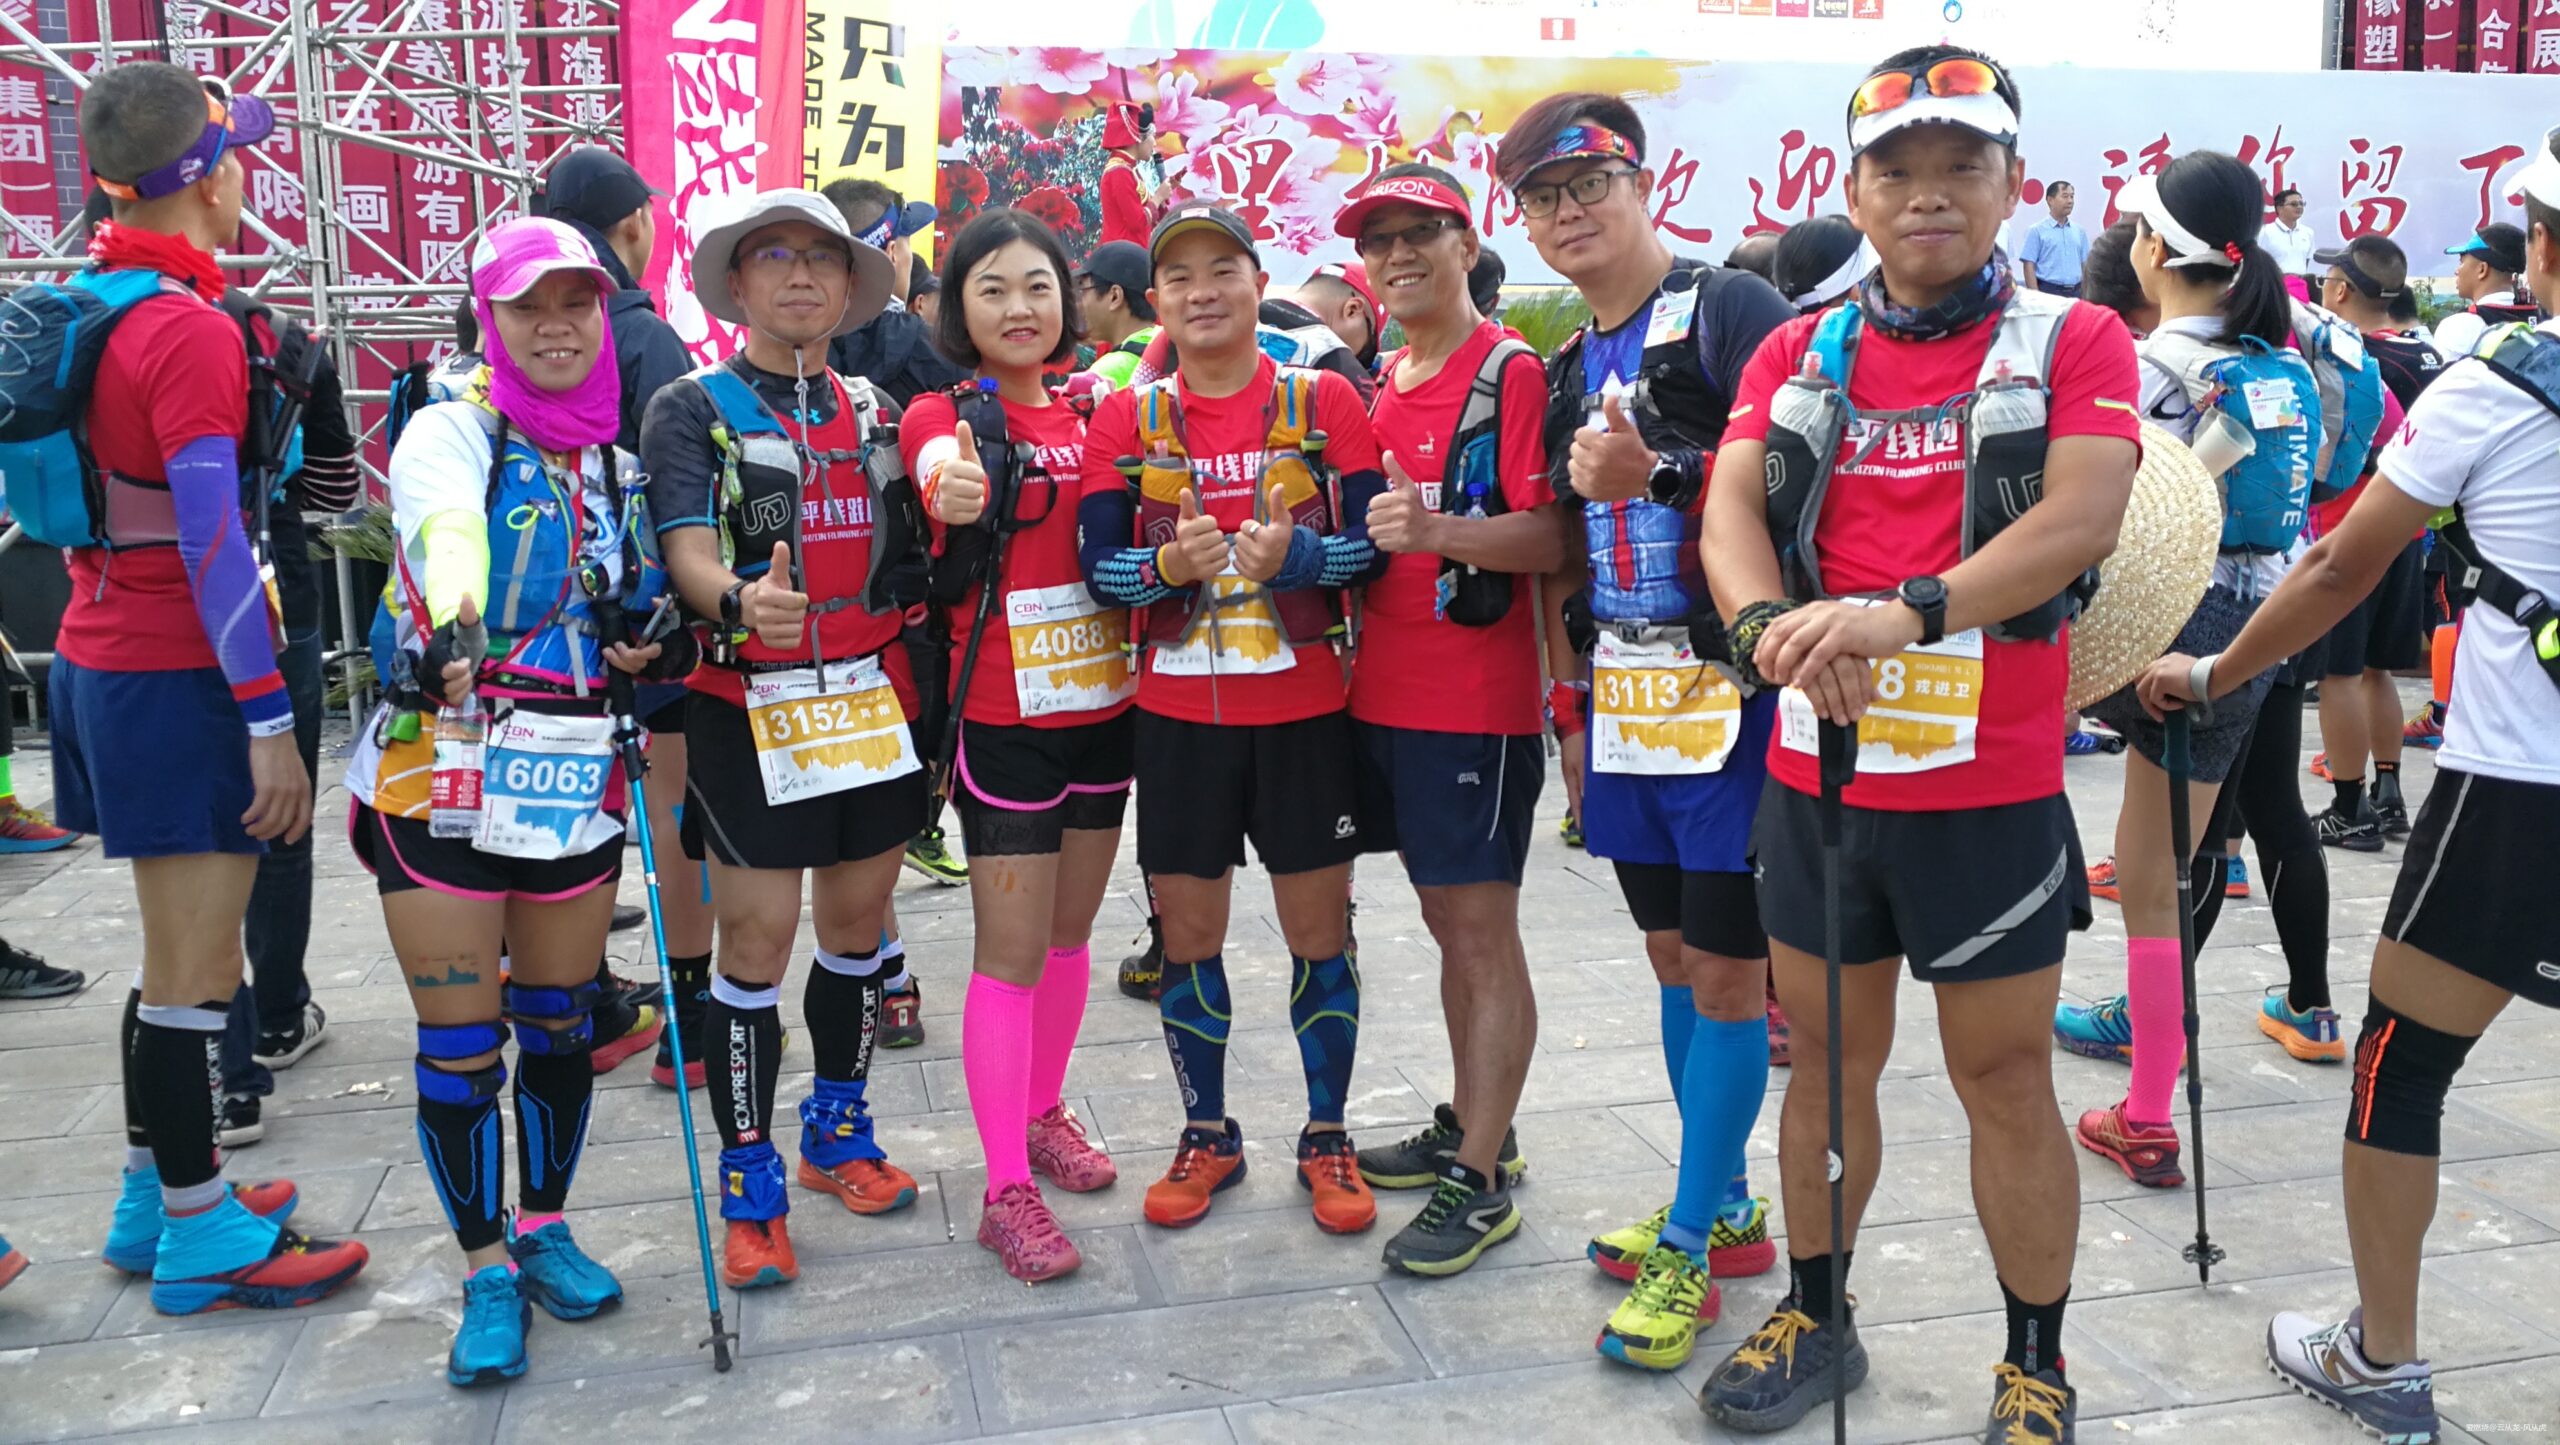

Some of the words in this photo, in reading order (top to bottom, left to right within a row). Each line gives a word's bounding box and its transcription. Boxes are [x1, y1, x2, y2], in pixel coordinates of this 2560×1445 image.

[803, 12, 825, 129] MADE
[1885, 463, 1933, 479] RUNNING
[1014, 602, 1042, 614] CBN
[1030, 621, 1105, 659] 4088
[753, 683, 781, 696] CBN
[1606, 675, 1681, 709] 3113
[502, 725, 535, 738] CBN
[769, 701, 855, 741] 3152
[506, 758, 602, 796] 6063
